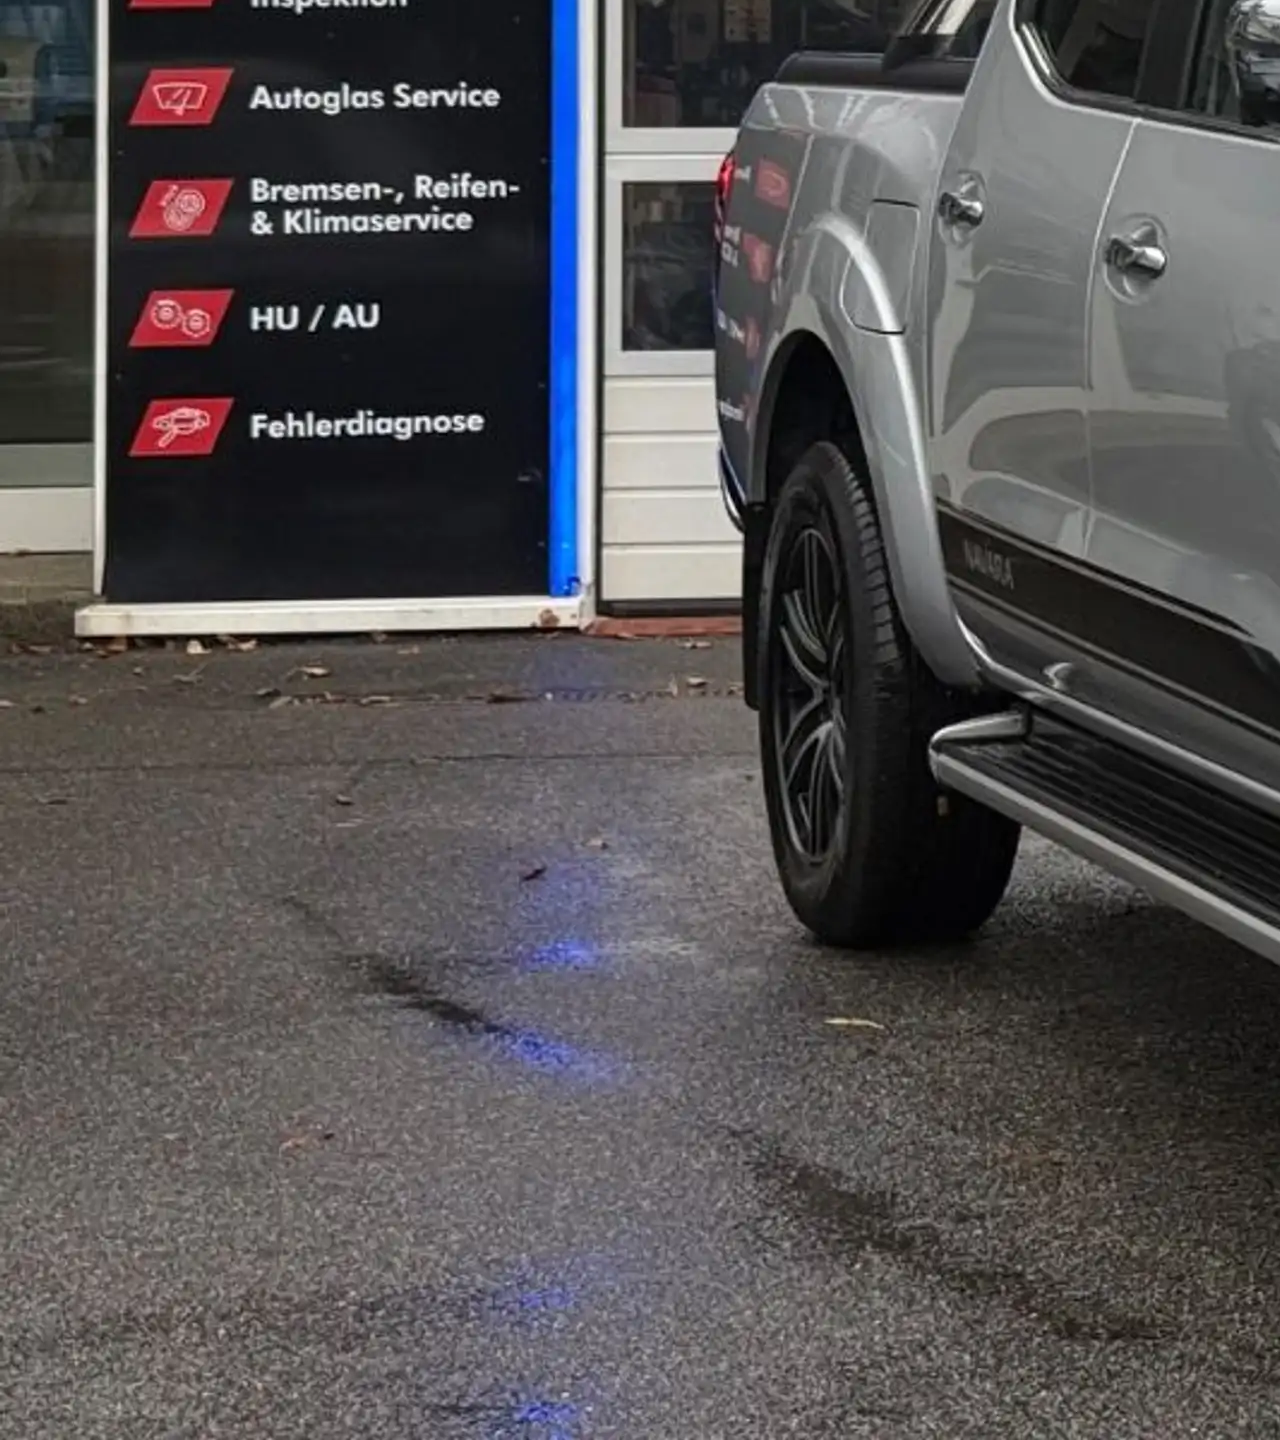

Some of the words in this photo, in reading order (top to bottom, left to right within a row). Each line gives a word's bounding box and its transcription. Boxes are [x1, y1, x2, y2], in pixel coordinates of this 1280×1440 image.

[249, 82, 385, 116] Autoglas
[393, 81, 501, 108] Service
[251, 177, 404, 204] Bremsen-,
[414, 172, 520, 199] Reifen-
[250, 210, 274, 235] &
[283, 205, 473, 235] Klimaservice
[250, 305, 299, 331] HU
[308, 304, 325, 332] /
[332, 303, 380, 329] AU
[251, 409, 485, 441] Fehlerdiagnose
